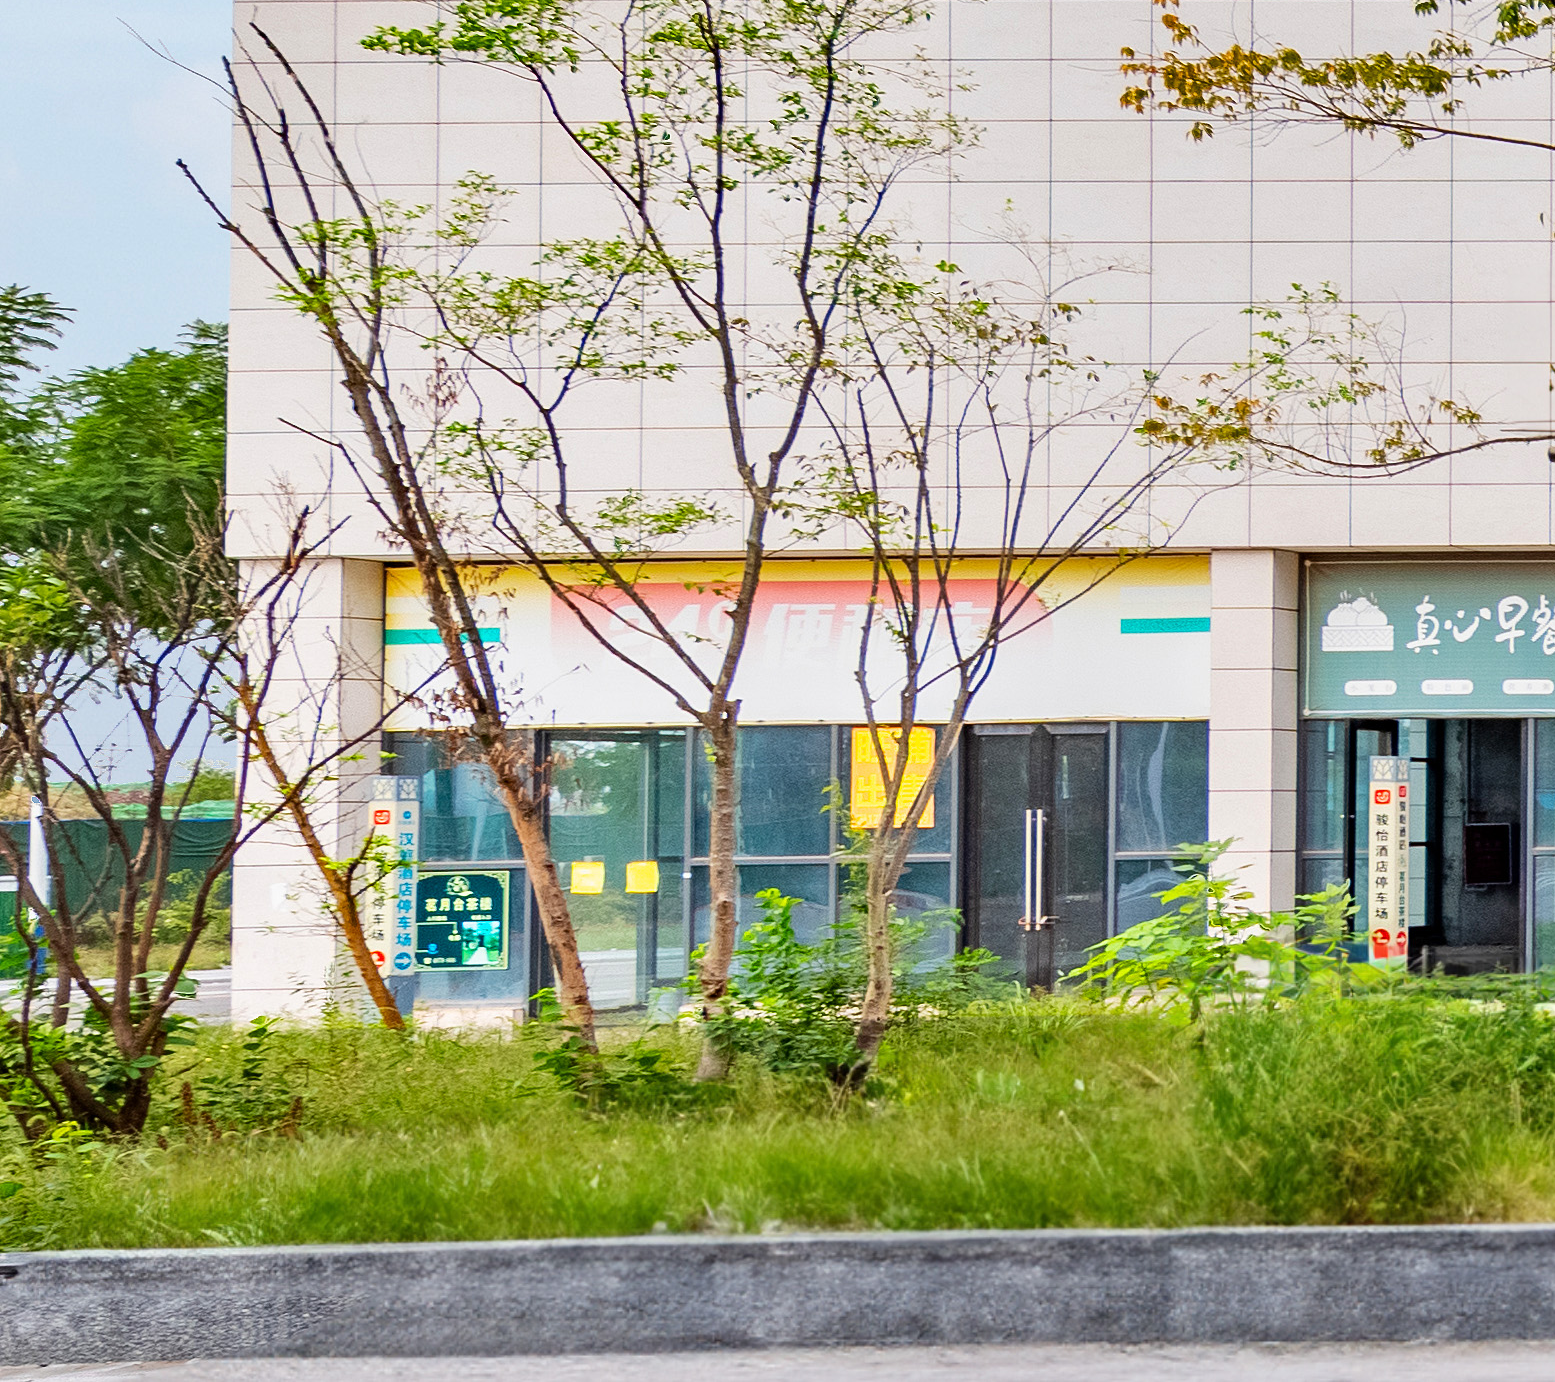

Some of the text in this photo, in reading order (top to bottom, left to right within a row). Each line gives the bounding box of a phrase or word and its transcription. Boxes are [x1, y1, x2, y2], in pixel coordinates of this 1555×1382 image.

[1375, 813, 1389, 920] 骏怡酒店停车场
